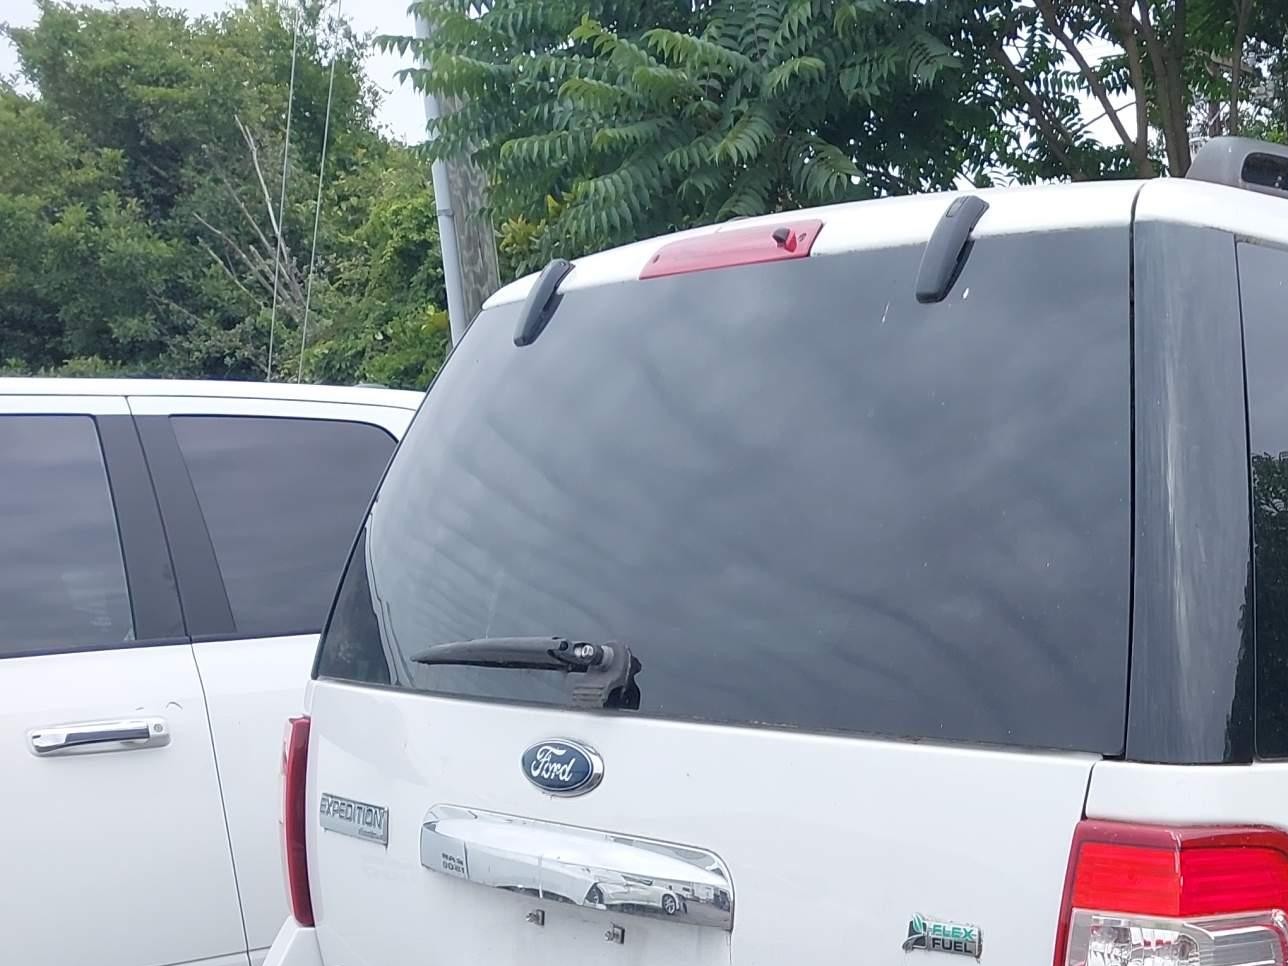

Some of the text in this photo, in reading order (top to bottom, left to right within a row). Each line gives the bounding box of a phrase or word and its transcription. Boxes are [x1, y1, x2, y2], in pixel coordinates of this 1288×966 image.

[530, 745, 576, 782] Ford
[320, 797, 385, 830] EXPEDITION
[932, 924, 974, 941] FLEX
[931, 937, 973, 954] FUEL
